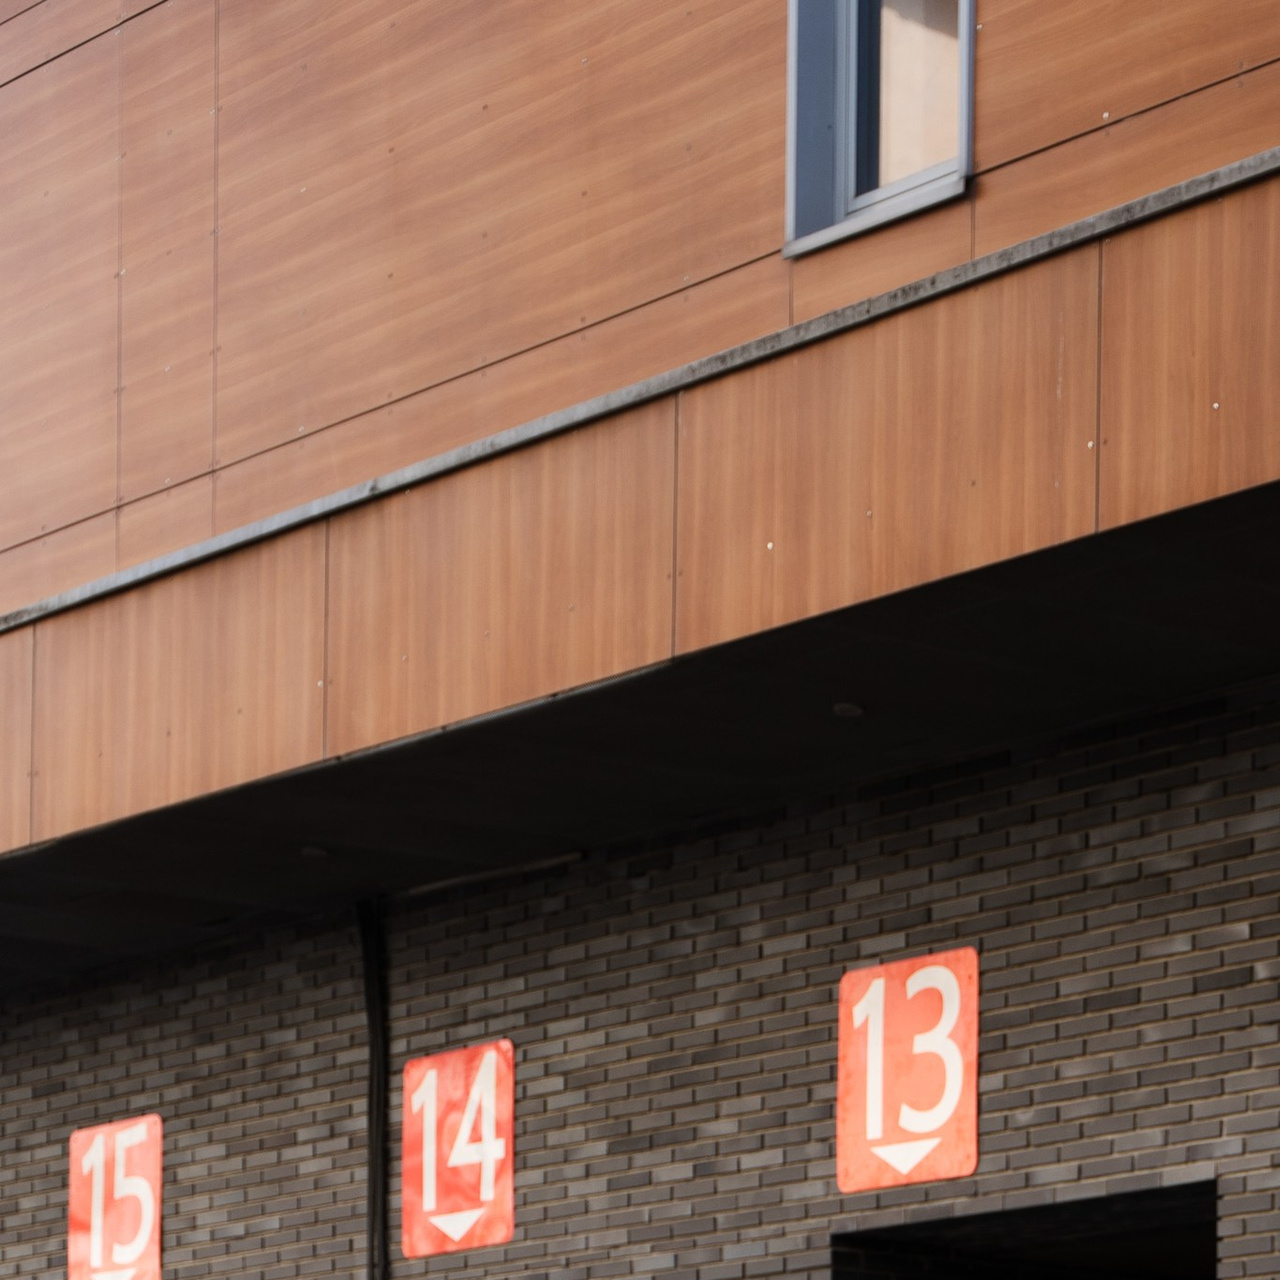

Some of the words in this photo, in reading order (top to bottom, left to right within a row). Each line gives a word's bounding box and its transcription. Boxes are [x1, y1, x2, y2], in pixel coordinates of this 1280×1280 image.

[411, 1050, 505, 1213] 14
[852, 965, 964, 1140] 13
[81, 1122, 155, 1268] 15
